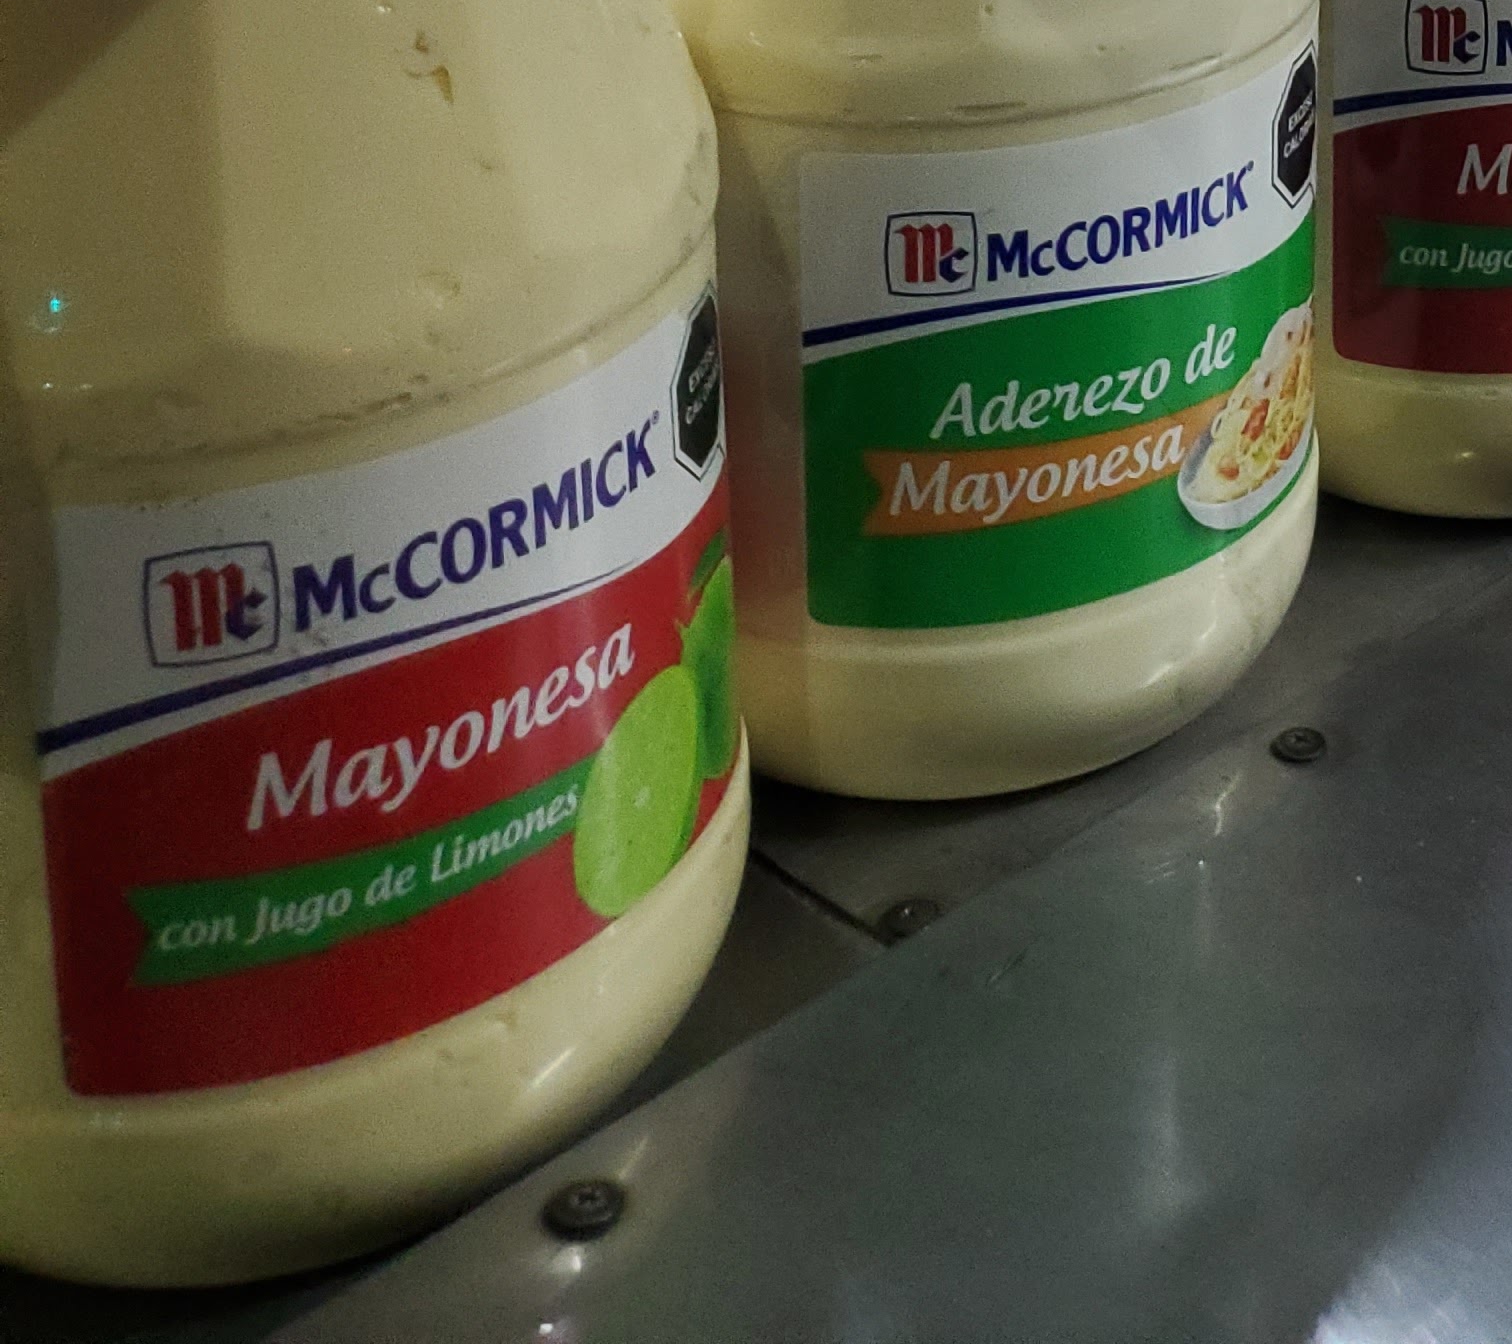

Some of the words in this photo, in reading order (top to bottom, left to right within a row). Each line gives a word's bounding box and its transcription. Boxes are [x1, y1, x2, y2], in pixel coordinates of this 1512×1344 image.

[986, 169, 1250, 282] McCORMICK
[1400, 244, 1447, 268] con
[930, 356, 1172, 440] Aderezo
[1185, 322, 1239, 386] de
[291, 421, 657, 633] McCORMICK
[888, 422, 1189, 525] Mayonesa
[246, 622, 636, 832] Mayonesa
[156, 910, 238, 955] con
[246, 885, 353, 945] Jugo
[363, 862, 419, 911] de
[429, 787, 580, 884] Limones
